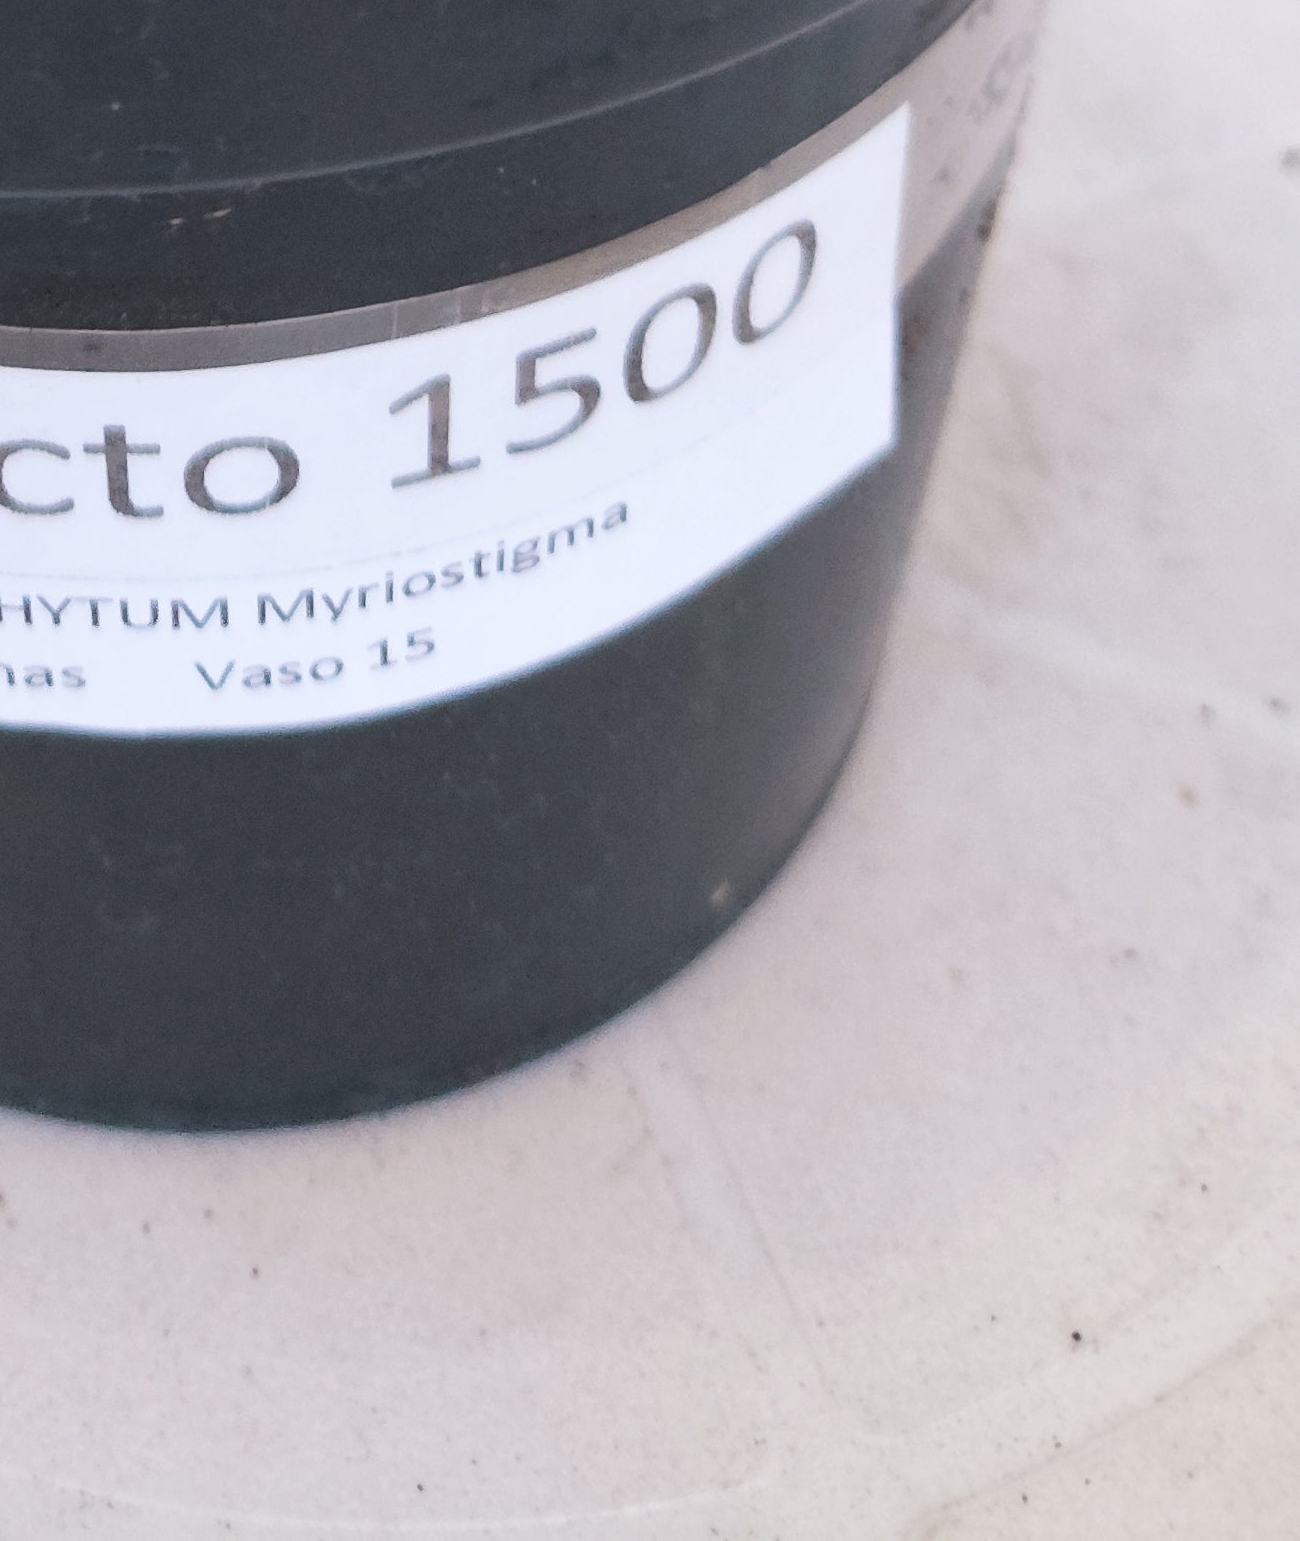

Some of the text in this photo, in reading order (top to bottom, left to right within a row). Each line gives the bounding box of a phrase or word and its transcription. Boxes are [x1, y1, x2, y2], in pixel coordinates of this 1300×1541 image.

[389, 218, 817, 489] 1500
[255, 501, 629, 623] Myriostigma
[194, 653, 345, 691] Vaso
[367, 627, 437, 674] 15
